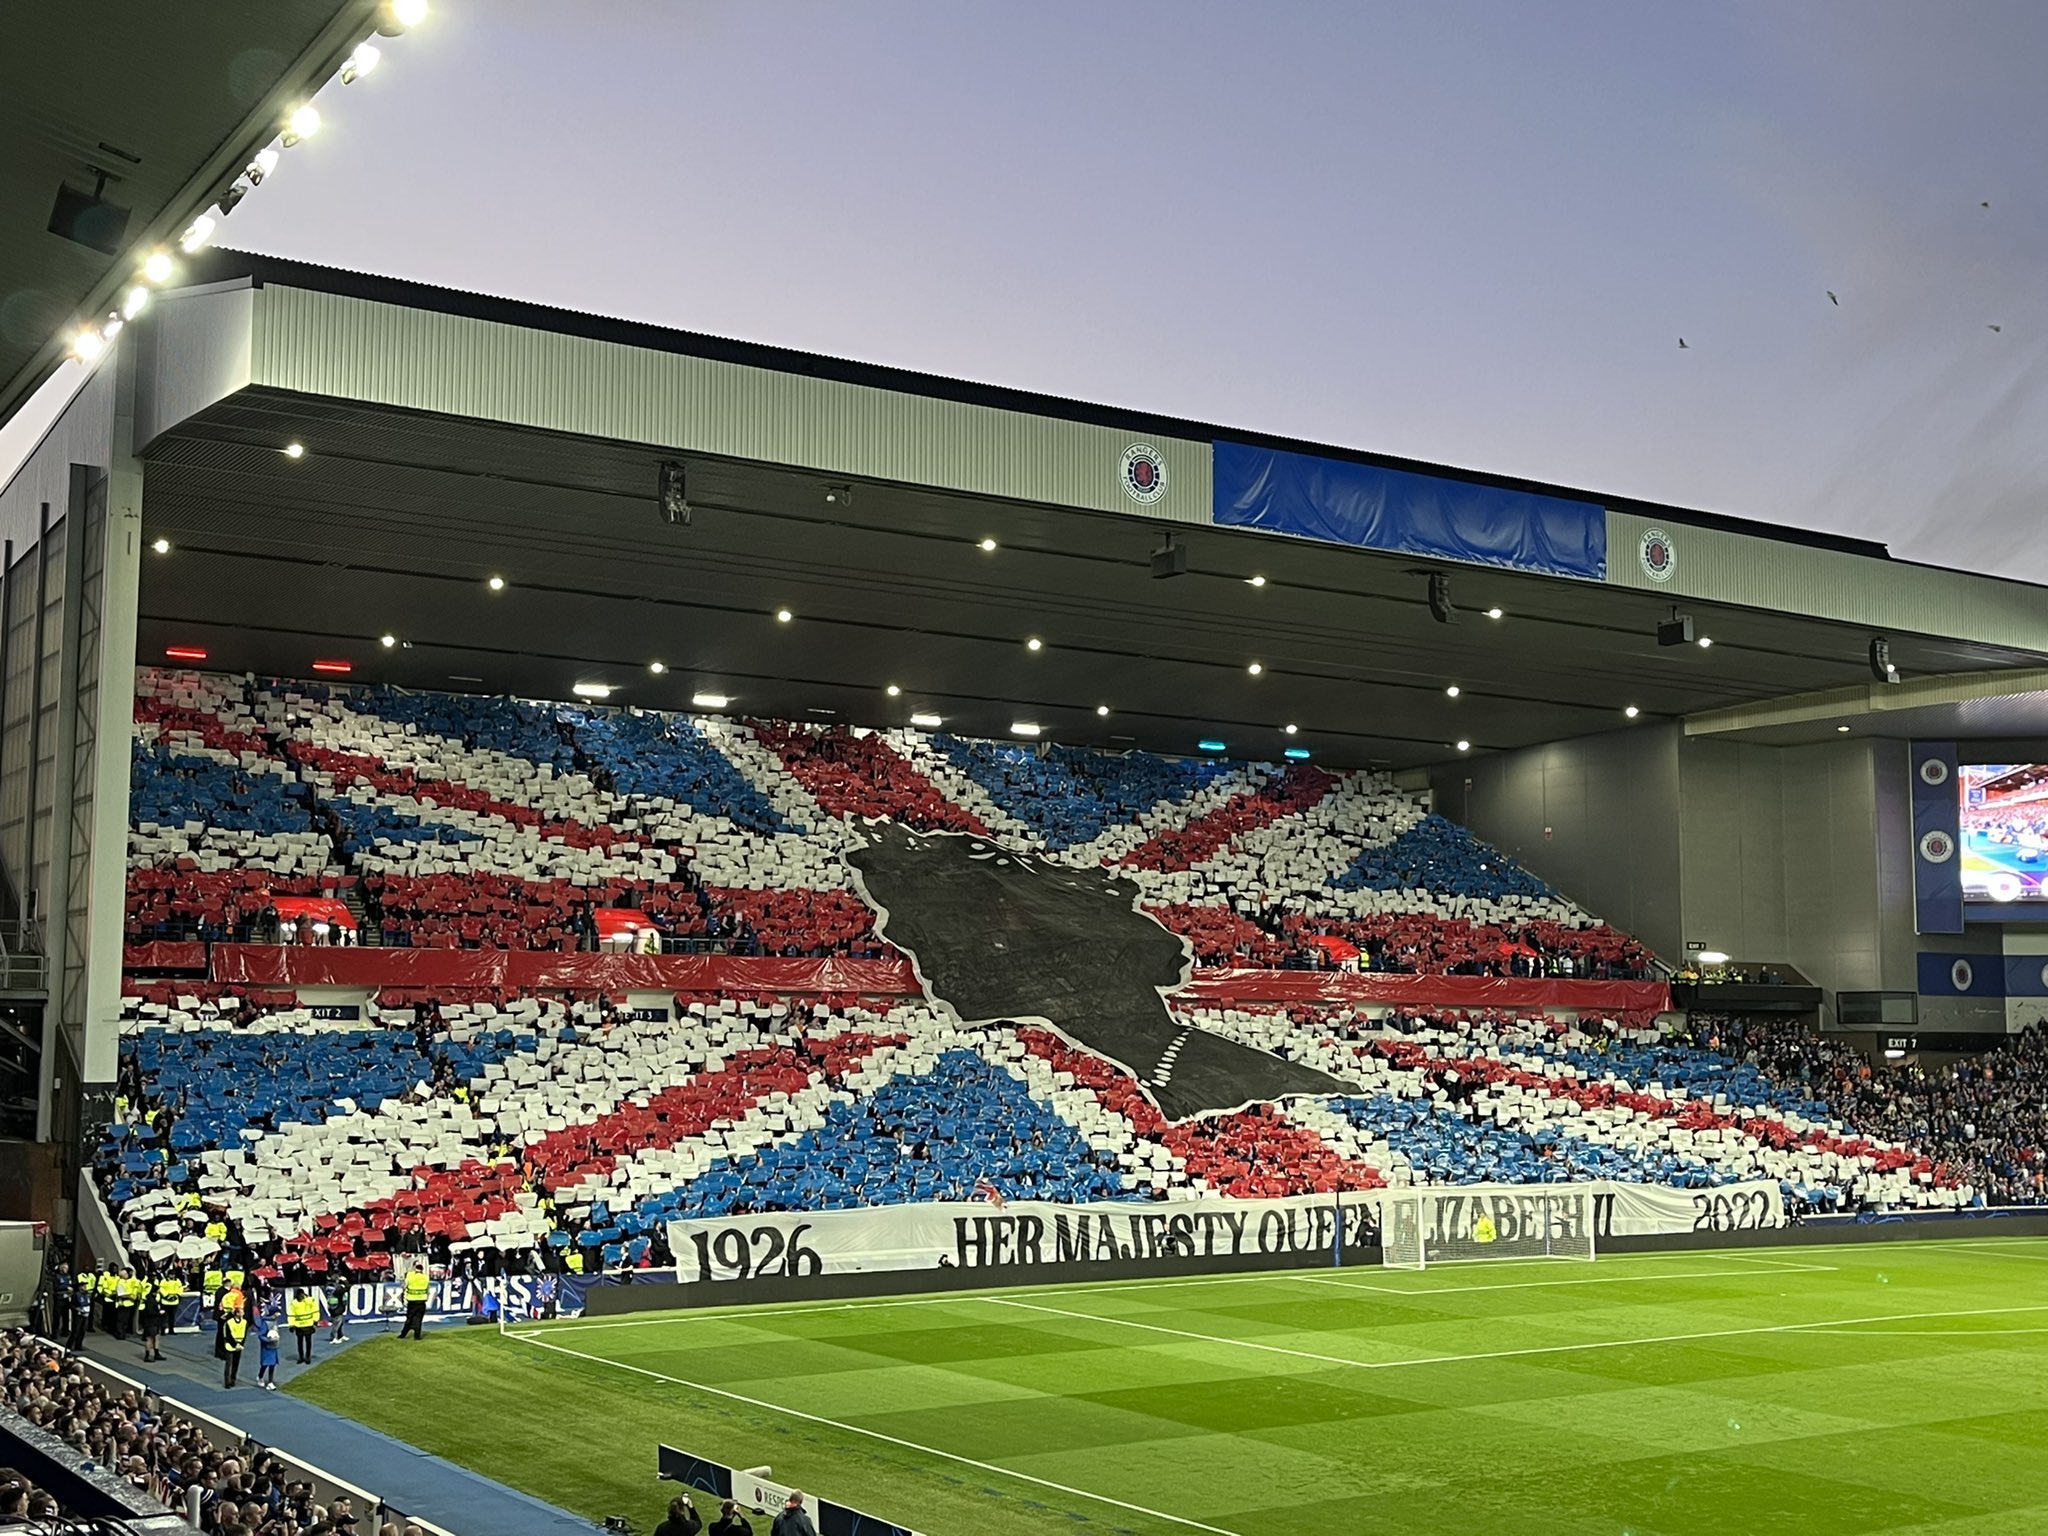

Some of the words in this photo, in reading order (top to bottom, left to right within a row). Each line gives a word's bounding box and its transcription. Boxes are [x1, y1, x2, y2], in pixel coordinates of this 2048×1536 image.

[1125, 446, 1163, 467] RANGERS
[1122, 476, 1152, 501] FOOTBALL
[335, 1008, 342, 1018] 2
[1888, 1038, 1907, 1048] EXIT
[1911, 1038, 1918, 1048] 7
[690, 1224, 822, 1280] 1926
[953, 1214, 1044, 1267] HER
[1054, 1210, 1249, 1263] MAJESTY
[1692, 1190, 1776, 1231] 2022
[764, 1491, 789, 1509] RESPE
